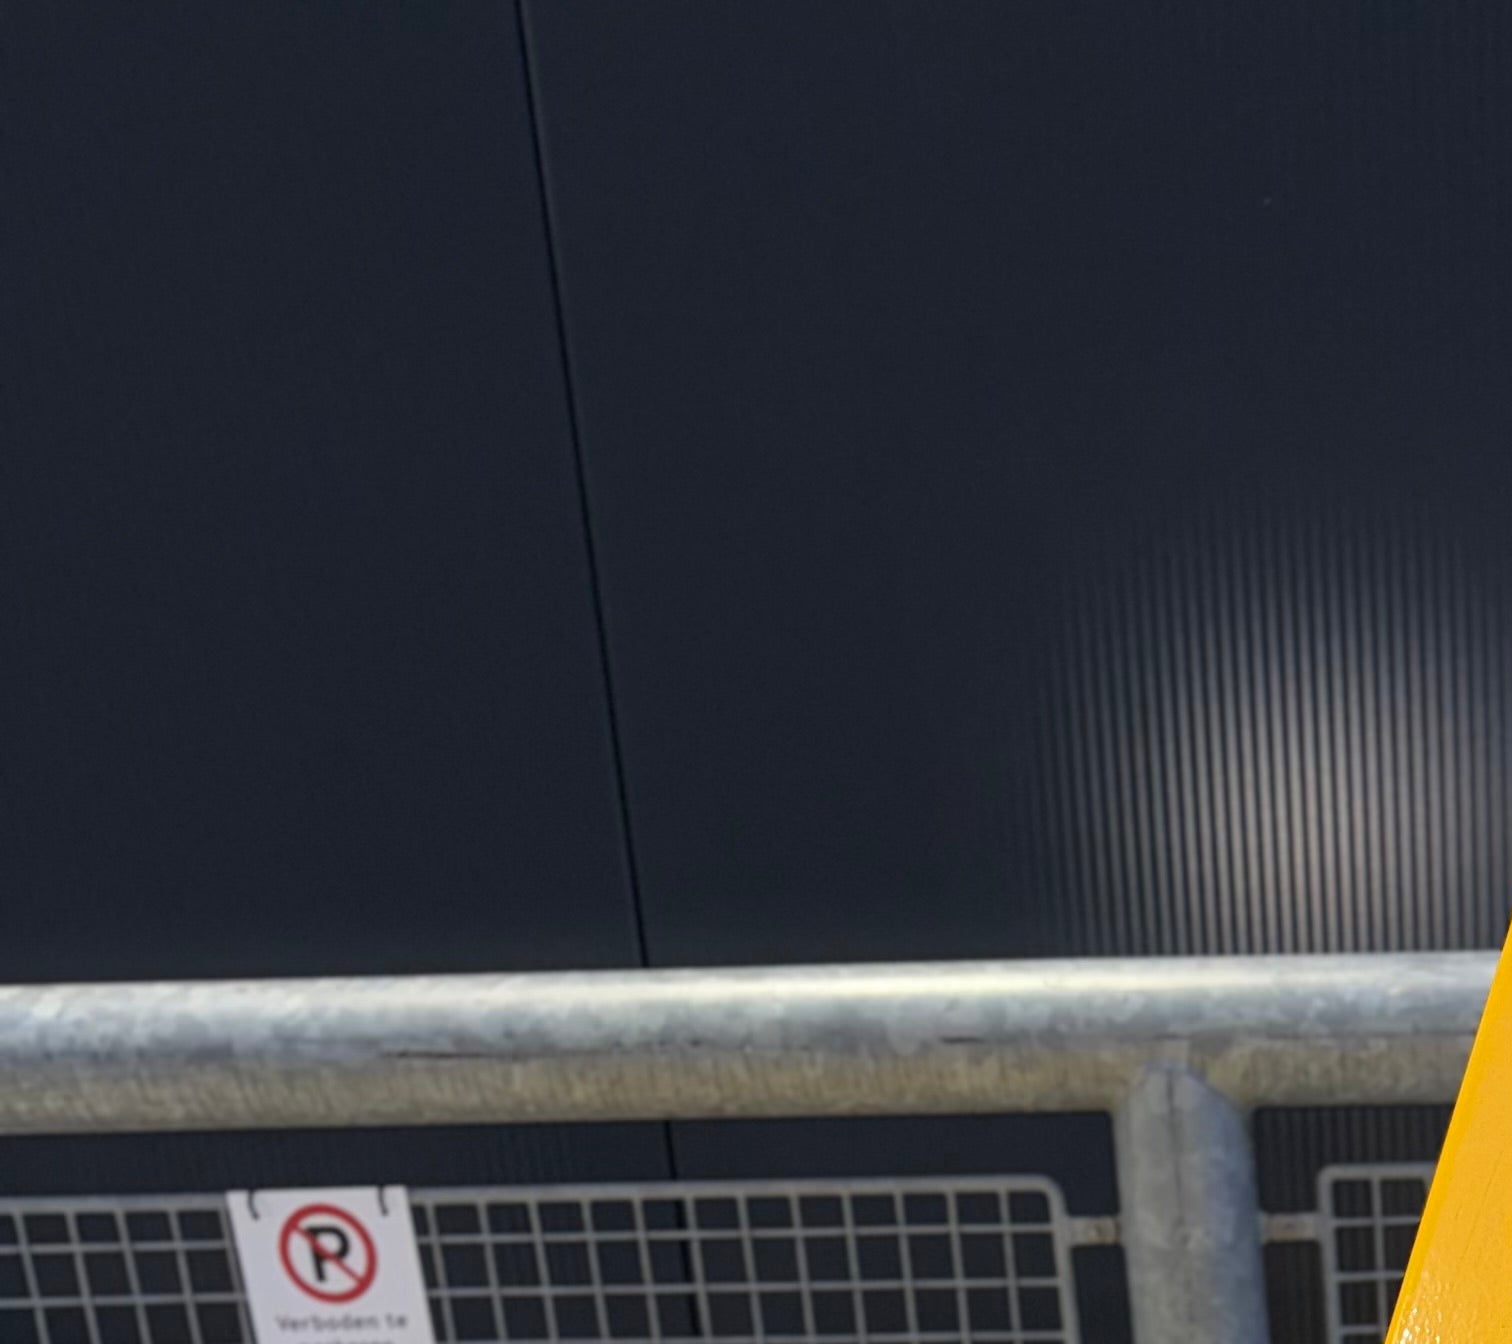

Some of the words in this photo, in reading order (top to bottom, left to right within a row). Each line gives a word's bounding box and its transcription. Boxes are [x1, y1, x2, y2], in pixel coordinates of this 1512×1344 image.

[304, 1226, 349, 1282] P
[276, 1314, 379, 1331] Verboden
[386, 1313, 406, 1329] te
